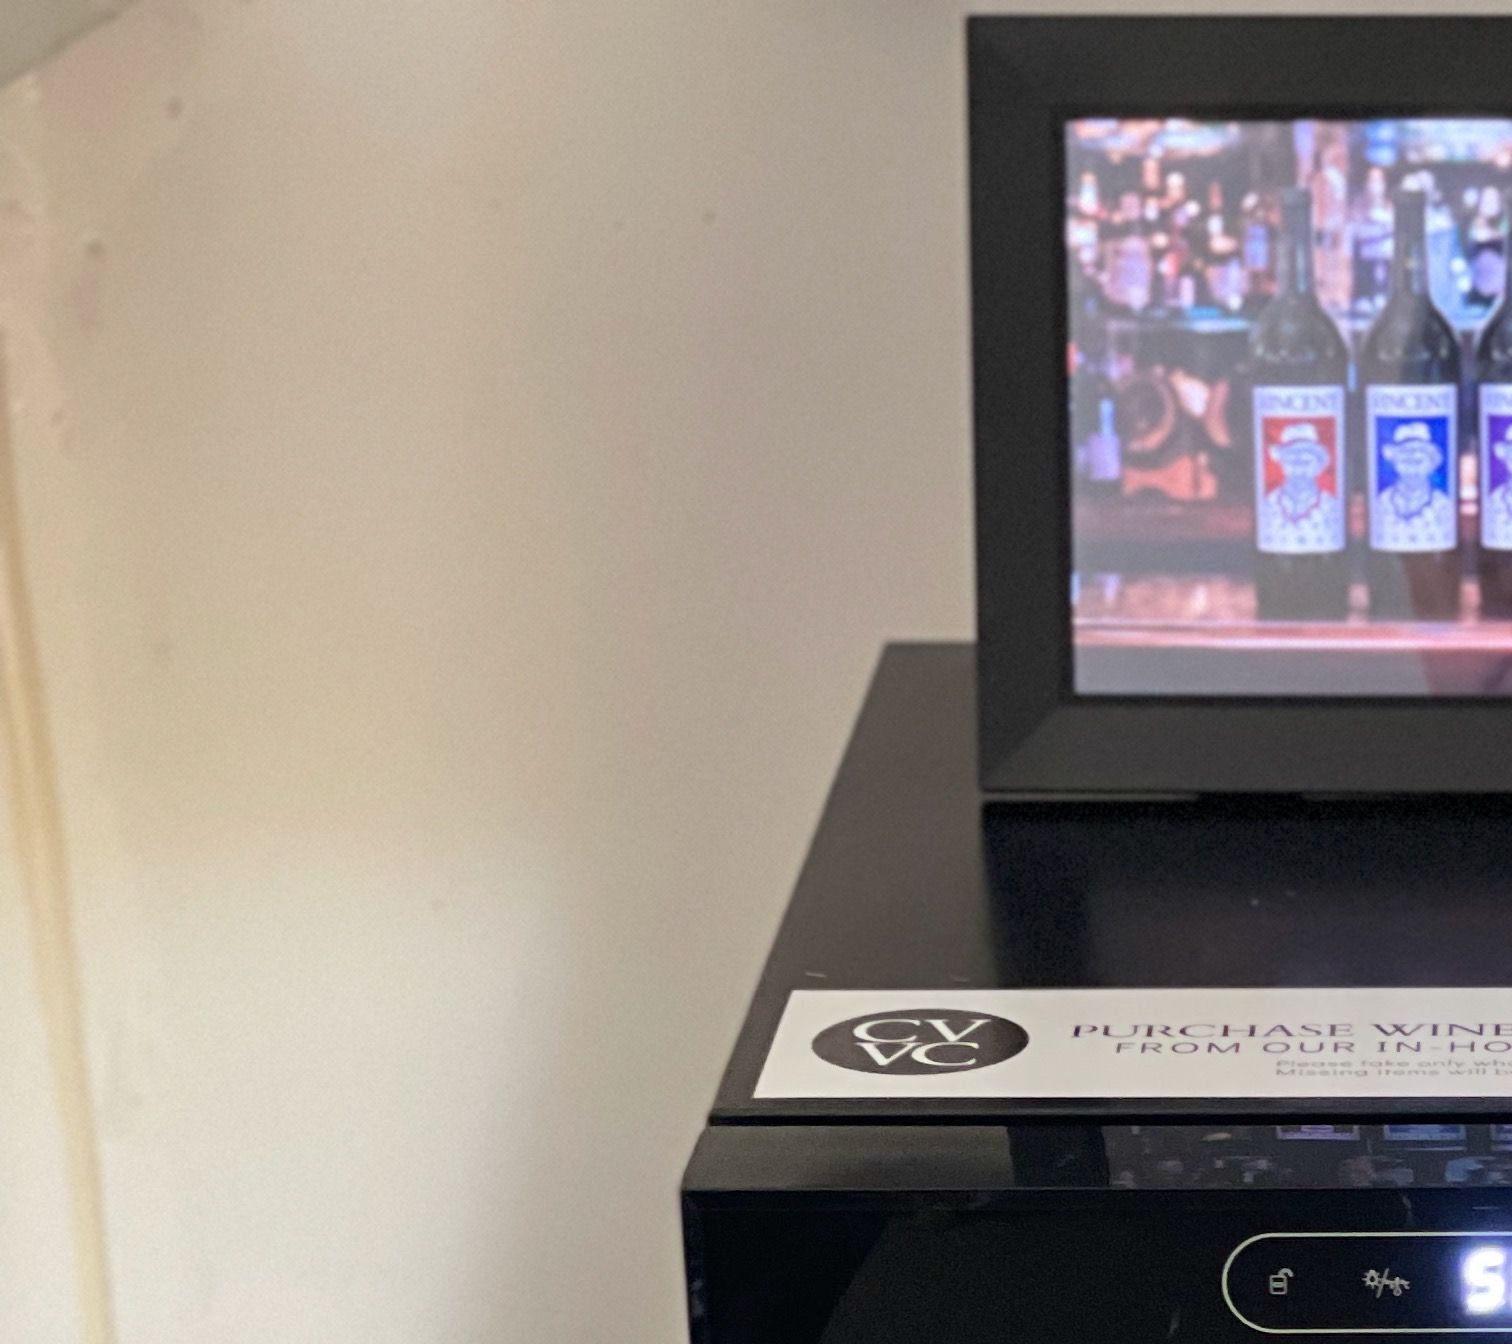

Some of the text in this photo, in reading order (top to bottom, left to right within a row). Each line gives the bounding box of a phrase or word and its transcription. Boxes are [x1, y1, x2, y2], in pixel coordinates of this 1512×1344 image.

[852, 1018, 992, 1043] CV
[1070, 1023, 1355, 1039] PURCHASE
[854, 1041, 980, 1067] VC
[1114, 1041, 1241, 1055] FROM
[1262, 1041, 1356, 1055] OUR
[1275, 1059, 1354, 1069] Please
[1361, 1059, 1411, 1068] take
[1417, 1059, 1465, 1069] only
[1275, 1068, 1368, 1078] Missing
[1377, 1068, 1440, 1077] items
[1448, 1068, 1487, 1077] will
